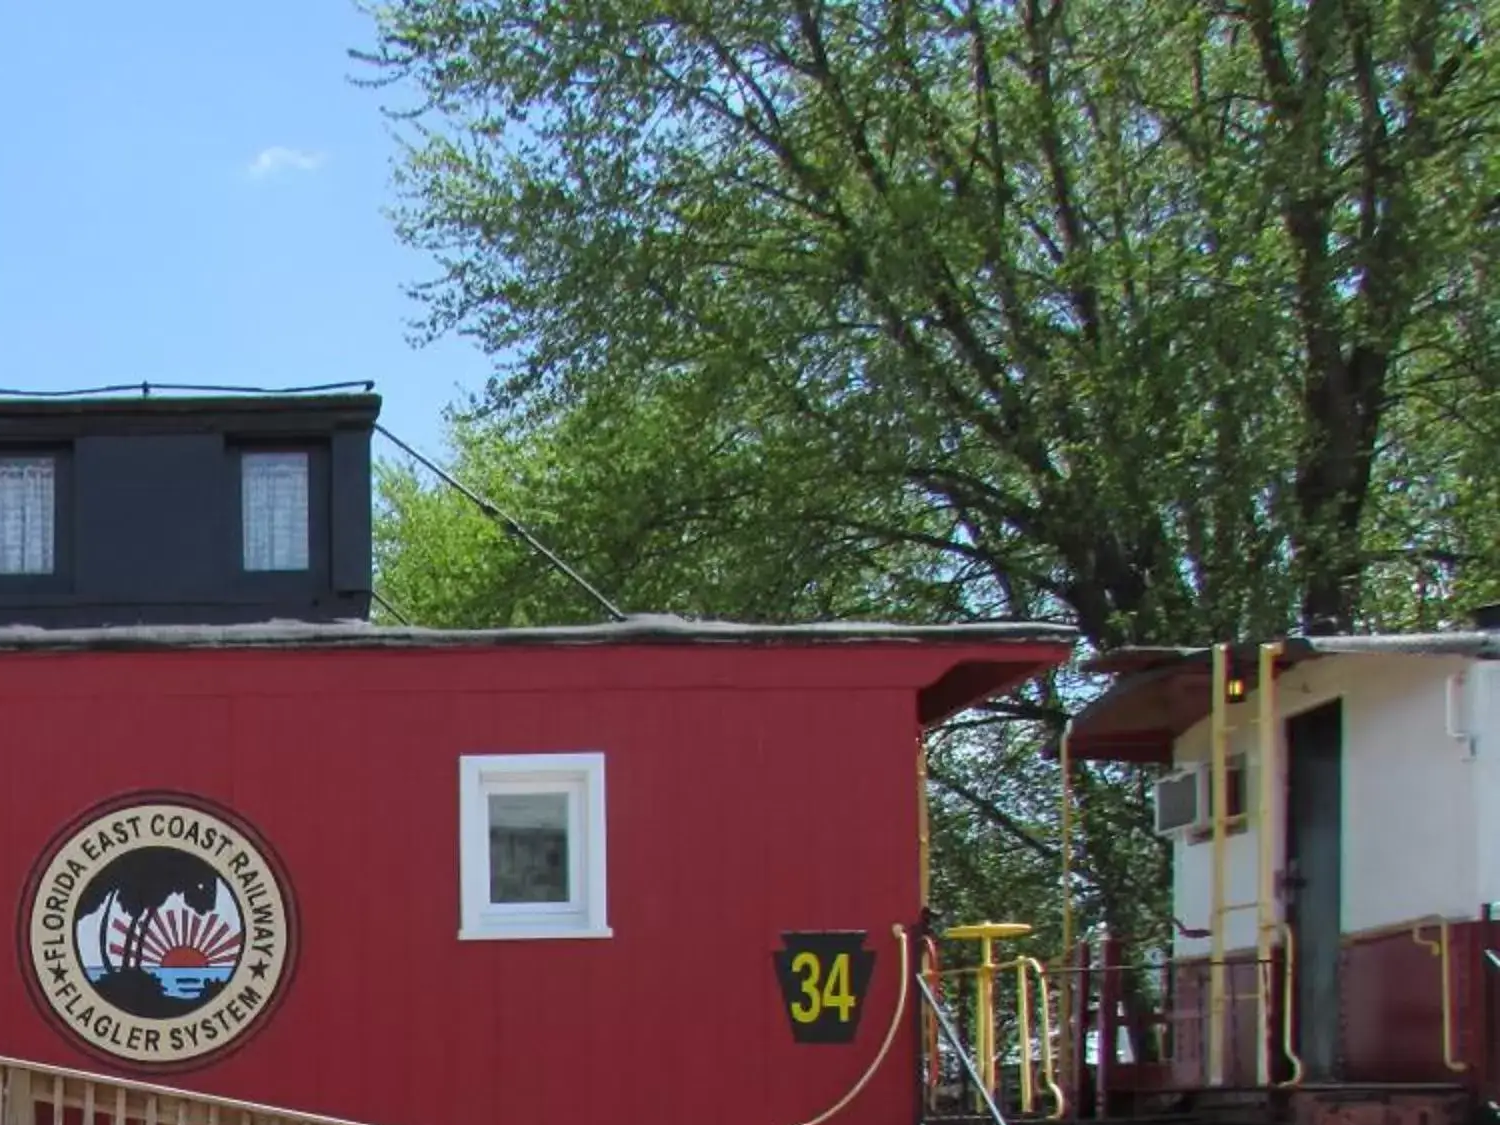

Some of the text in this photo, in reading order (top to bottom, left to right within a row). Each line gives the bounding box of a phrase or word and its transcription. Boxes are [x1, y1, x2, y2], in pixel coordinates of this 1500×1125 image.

[42, 813, 274, 961] FLORIDA EAST COAST RAILWAY
[54, 982, 263, 1051] FLAGLER SYSTEM
[791, 951, 856, 1023] 34
